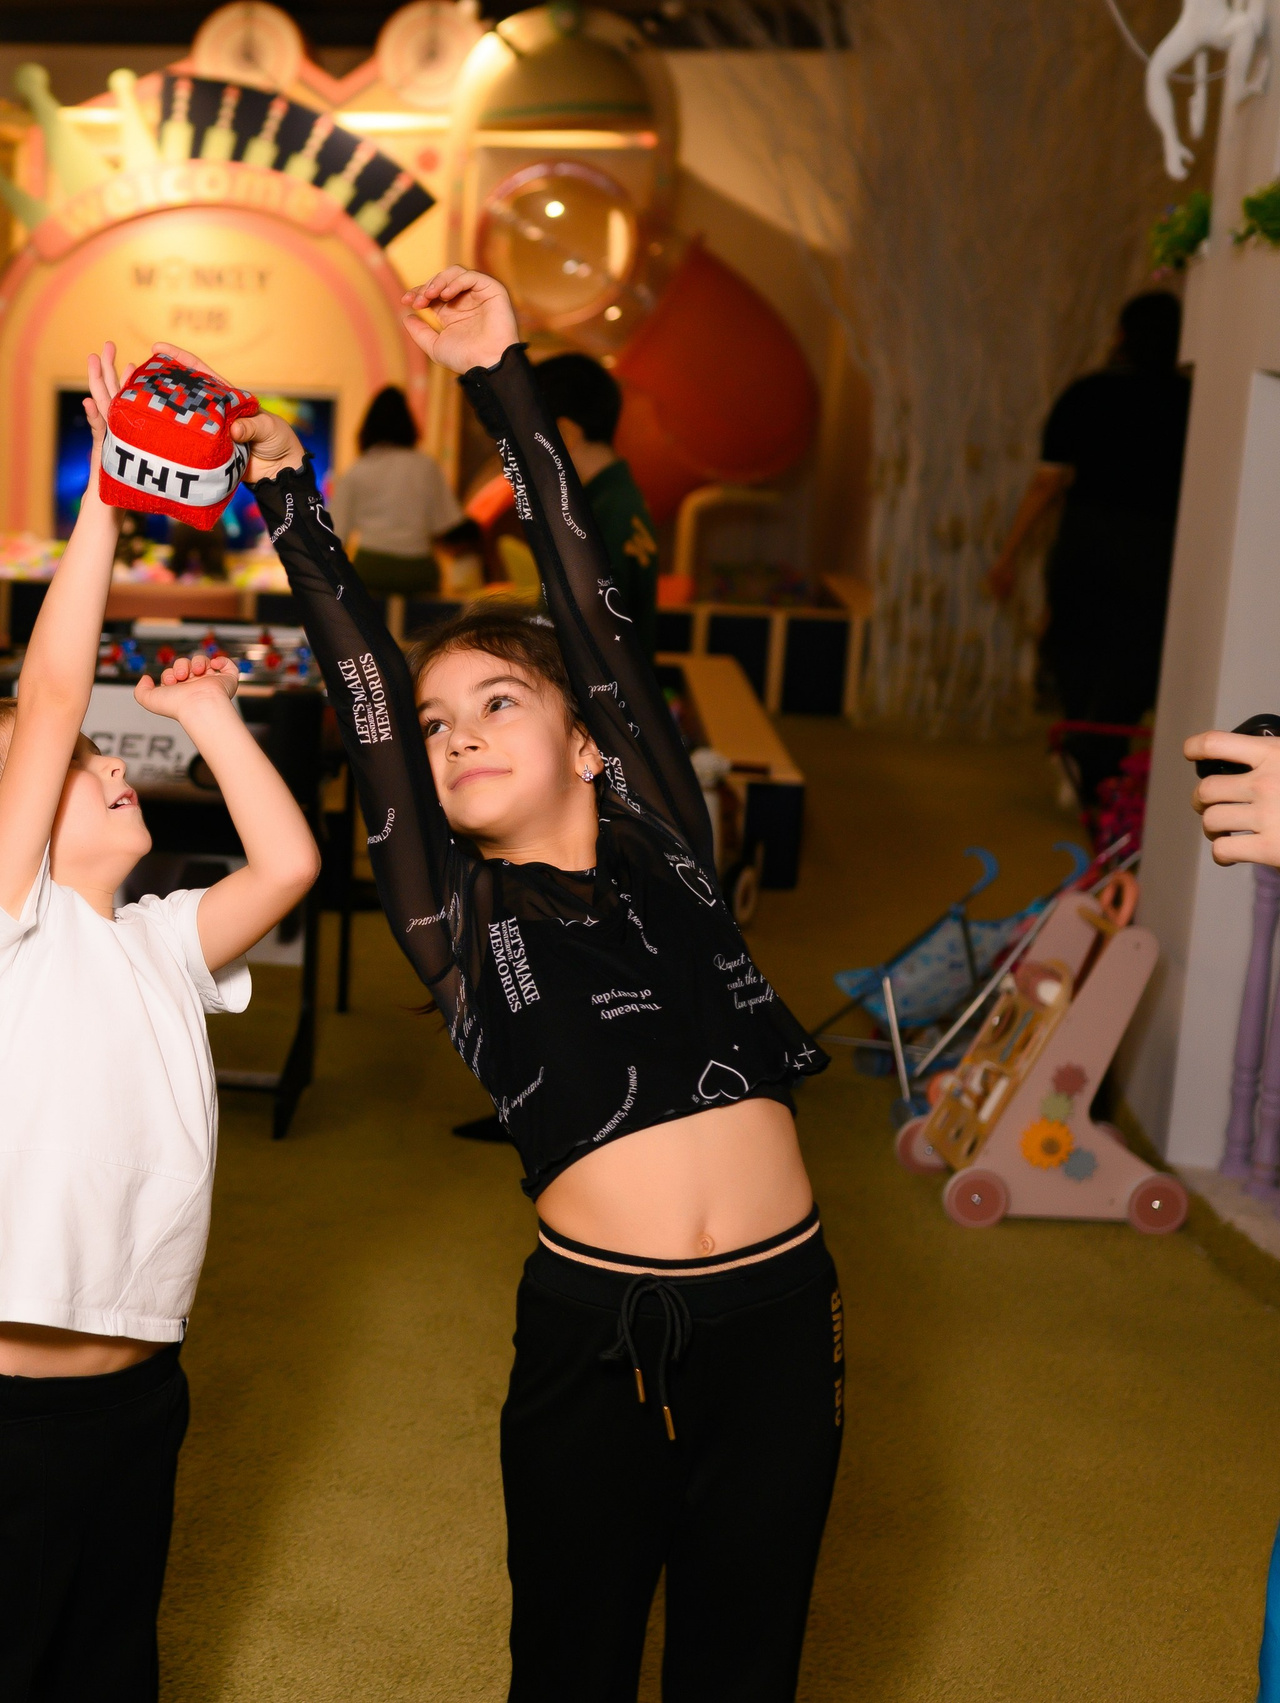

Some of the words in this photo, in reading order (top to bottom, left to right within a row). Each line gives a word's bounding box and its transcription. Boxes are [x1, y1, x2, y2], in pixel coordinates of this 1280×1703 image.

[533, 431, 556, 456] THINGS
[552, 454, 564, 470] NOT
[284, 492, 294, 527] COLLECT
[561, 511, 587, 540] COLLECT
[337, 658, 368, 703] MAKE
[359, 652, 393, 743] MEMORIES
[381, 807, 395, 841] COLLECT
[507, 916, 526, 959] LET'S
[488, 922, 522, 1013] MEMORIES
[513, 957, 541, 1006] MAKE
[591, 989, 638, 1006] everyday
[600, 1003, 640, 1020] beauty
[627, 1065, 638, 1095] THINGS
[622, 1095, 634, 1112] NOT
[593, 1111, 628, 1143] MOMENTS,
